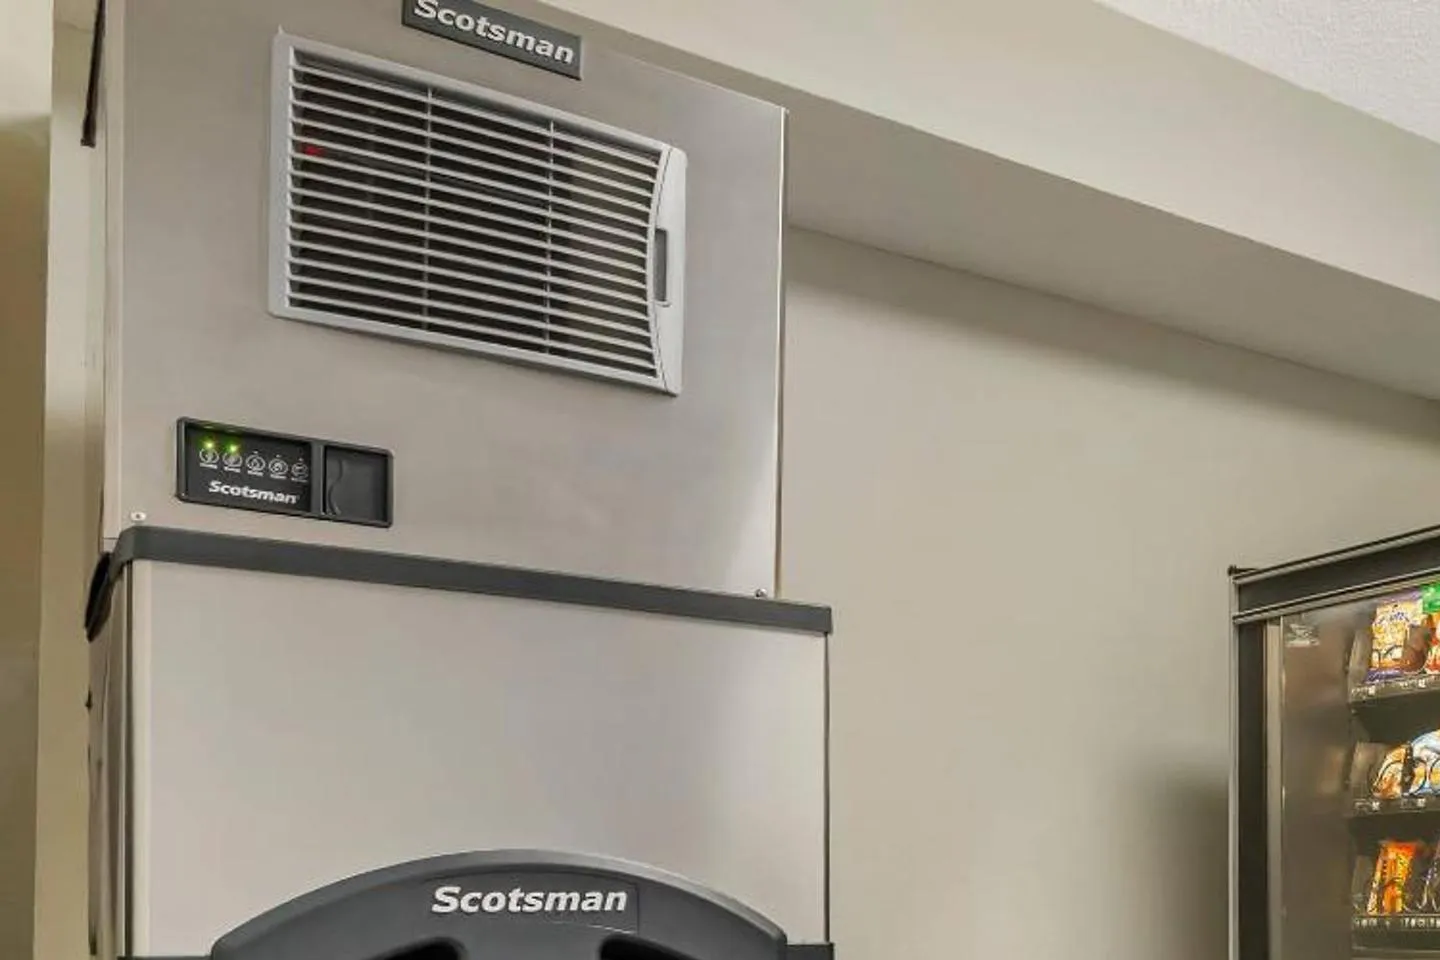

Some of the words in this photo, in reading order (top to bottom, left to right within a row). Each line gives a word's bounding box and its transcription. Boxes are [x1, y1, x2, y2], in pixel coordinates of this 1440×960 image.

[413, 0, 575, 64] Scotsman
[208, 479, 300, 505] Scotsman
[431, 886, 628, 914] Scotsman
